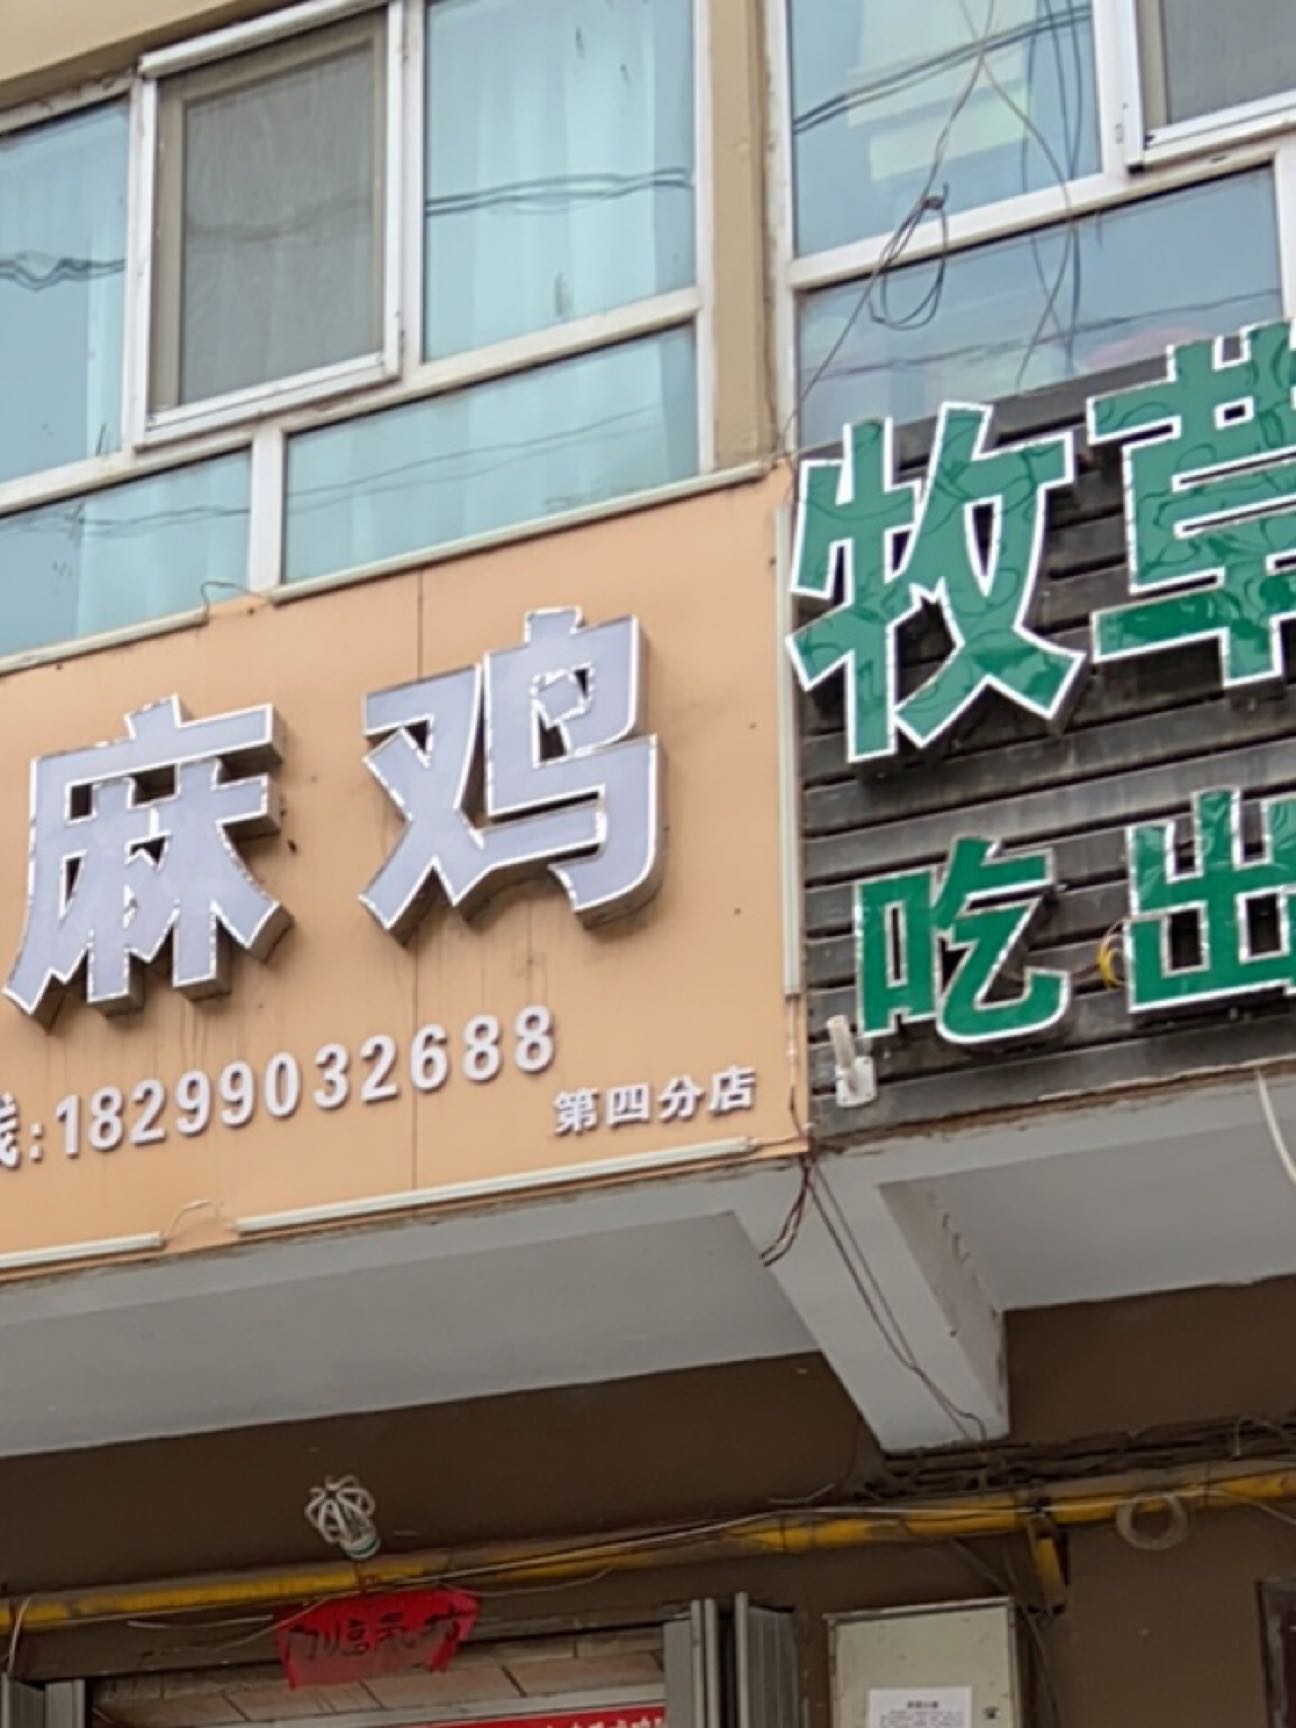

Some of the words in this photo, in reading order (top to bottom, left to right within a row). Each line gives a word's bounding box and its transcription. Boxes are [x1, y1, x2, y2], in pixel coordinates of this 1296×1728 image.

[854, 786, 1296, 1046] 吃出
[552, 1064, 758, 1136] 第四分店
